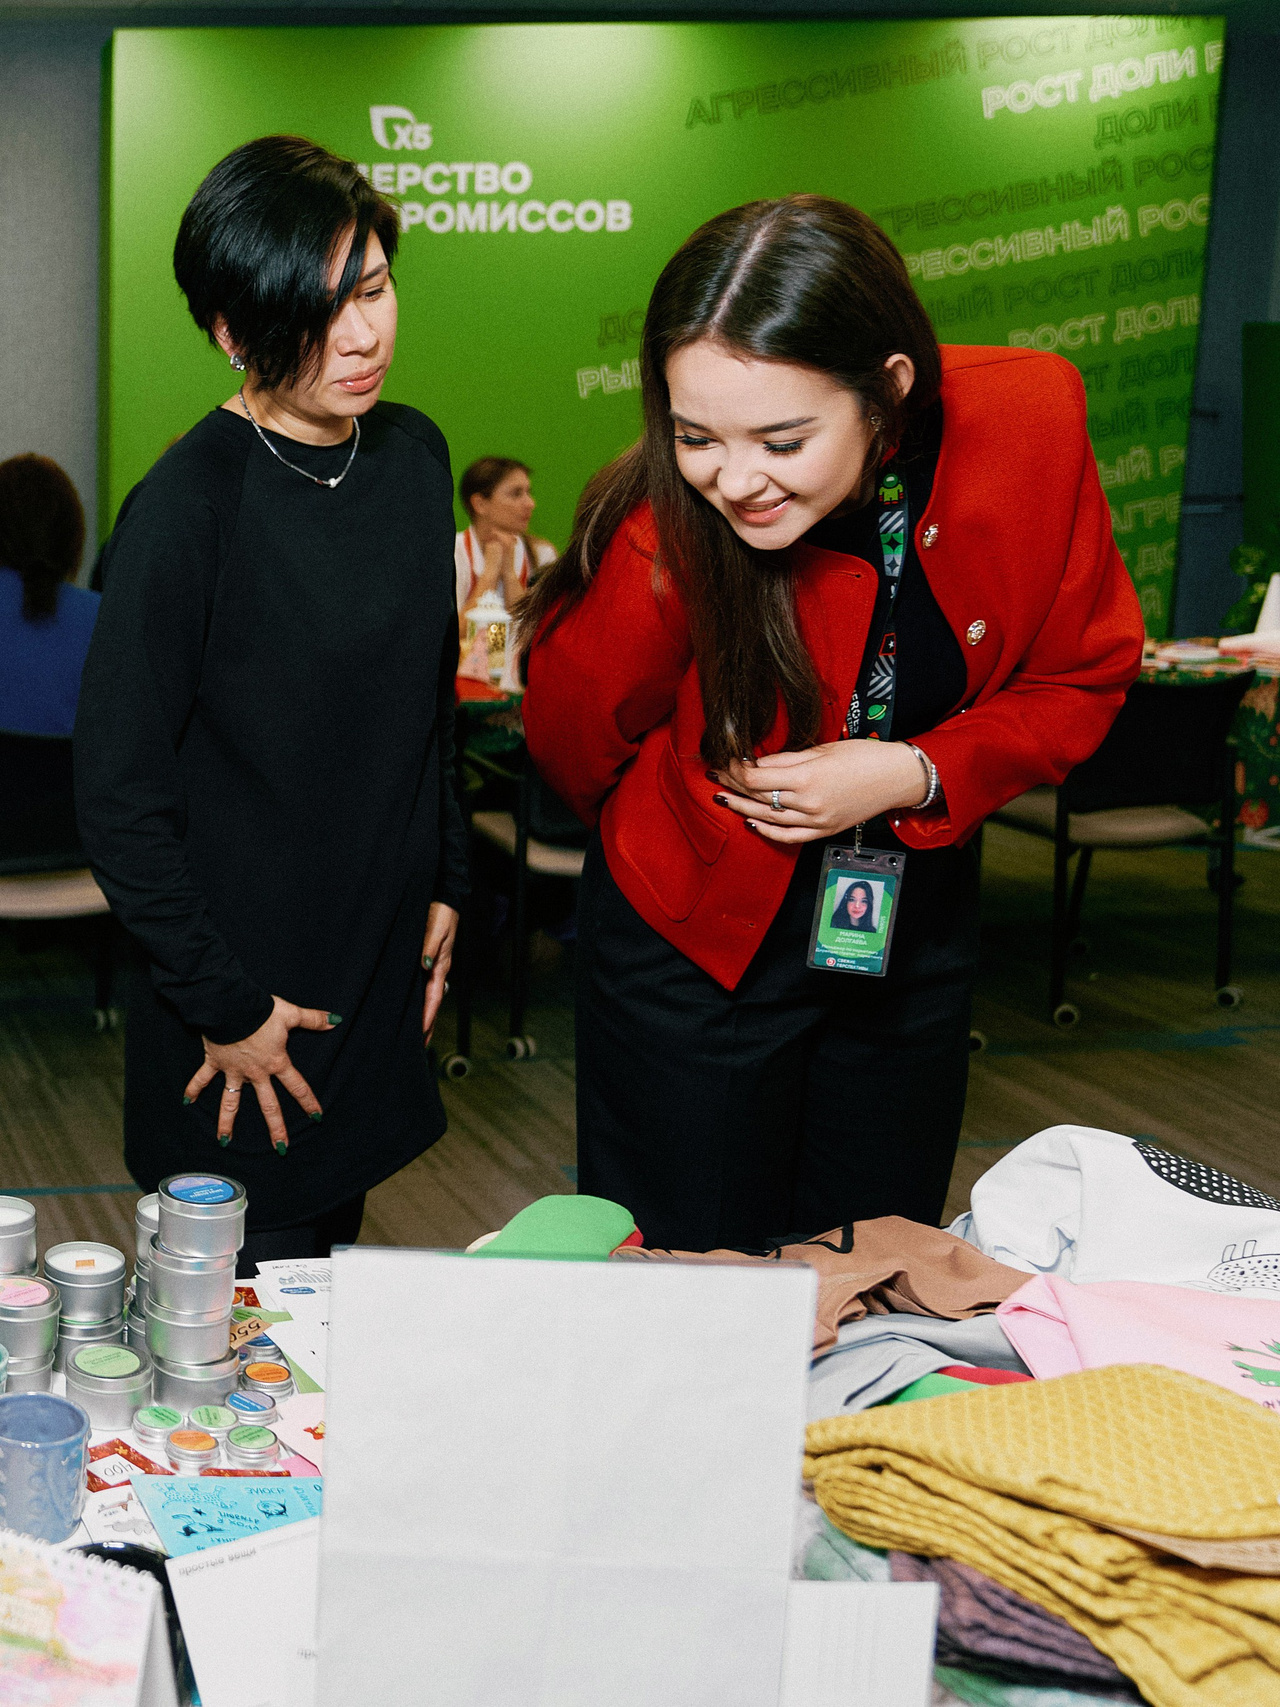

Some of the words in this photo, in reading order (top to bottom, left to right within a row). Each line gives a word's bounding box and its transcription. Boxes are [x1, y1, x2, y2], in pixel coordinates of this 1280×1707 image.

[684, 37, 967, 130] АГРЕССИВНЫЙ
[976, 24, 1076, 71] РОСТ
[981, 69, 1084, 120] РОСТ
[1088, 46, 1198, 104] ДОЛИ
[394, 200, 632, 233] РОМИССОВ
[905, 203, 1131, 282] РЕССИВНЫЙ
